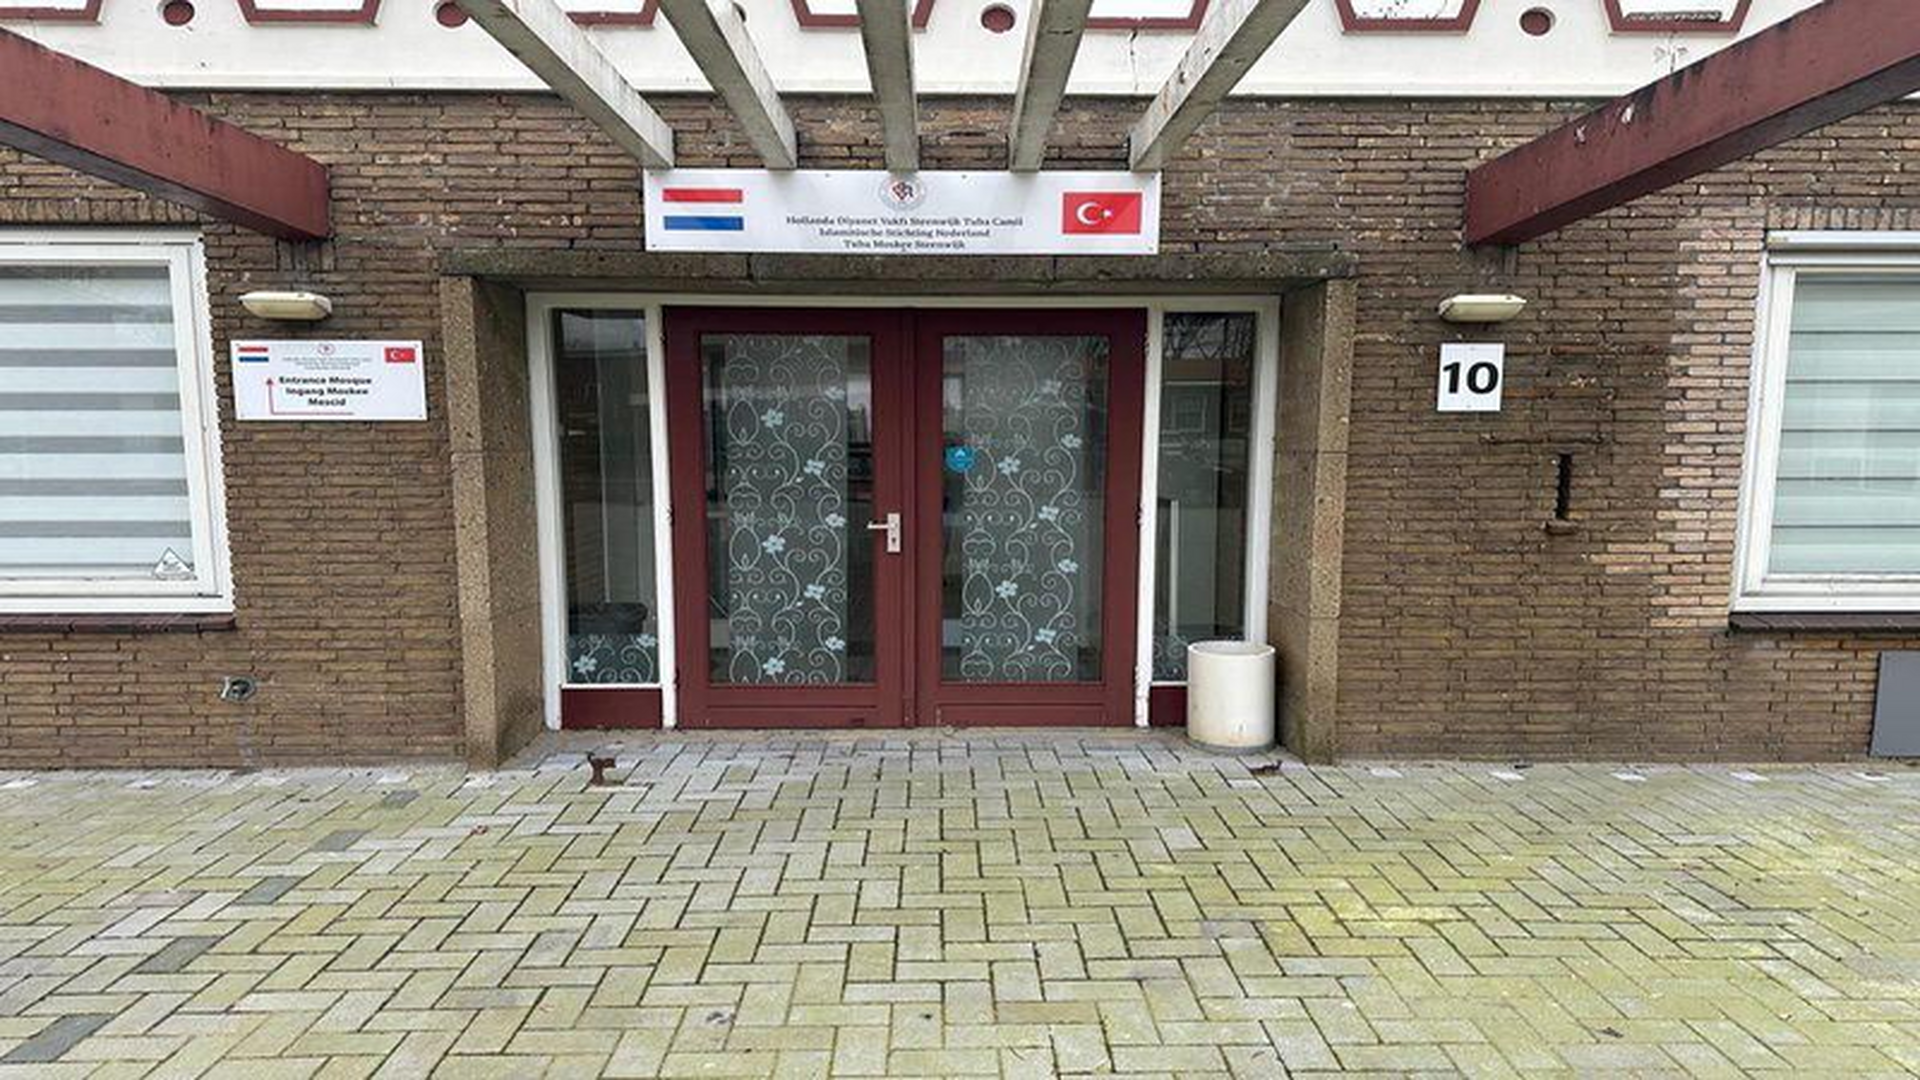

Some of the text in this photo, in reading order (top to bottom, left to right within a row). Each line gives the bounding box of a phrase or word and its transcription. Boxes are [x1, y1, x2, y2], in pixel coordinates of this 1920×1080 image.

[962, 217, 990, 225] Tuba
[885, 228, 934, 238] Stichting
[936, 228, 990, 236] Nederland
[279, 376, 372, 386] Entrance Mosque
[1443, 361, 1499, 395] 10
[286, 387, 369, 397] Ingang Moskee
[308, 398, 347, 406] Mescid
